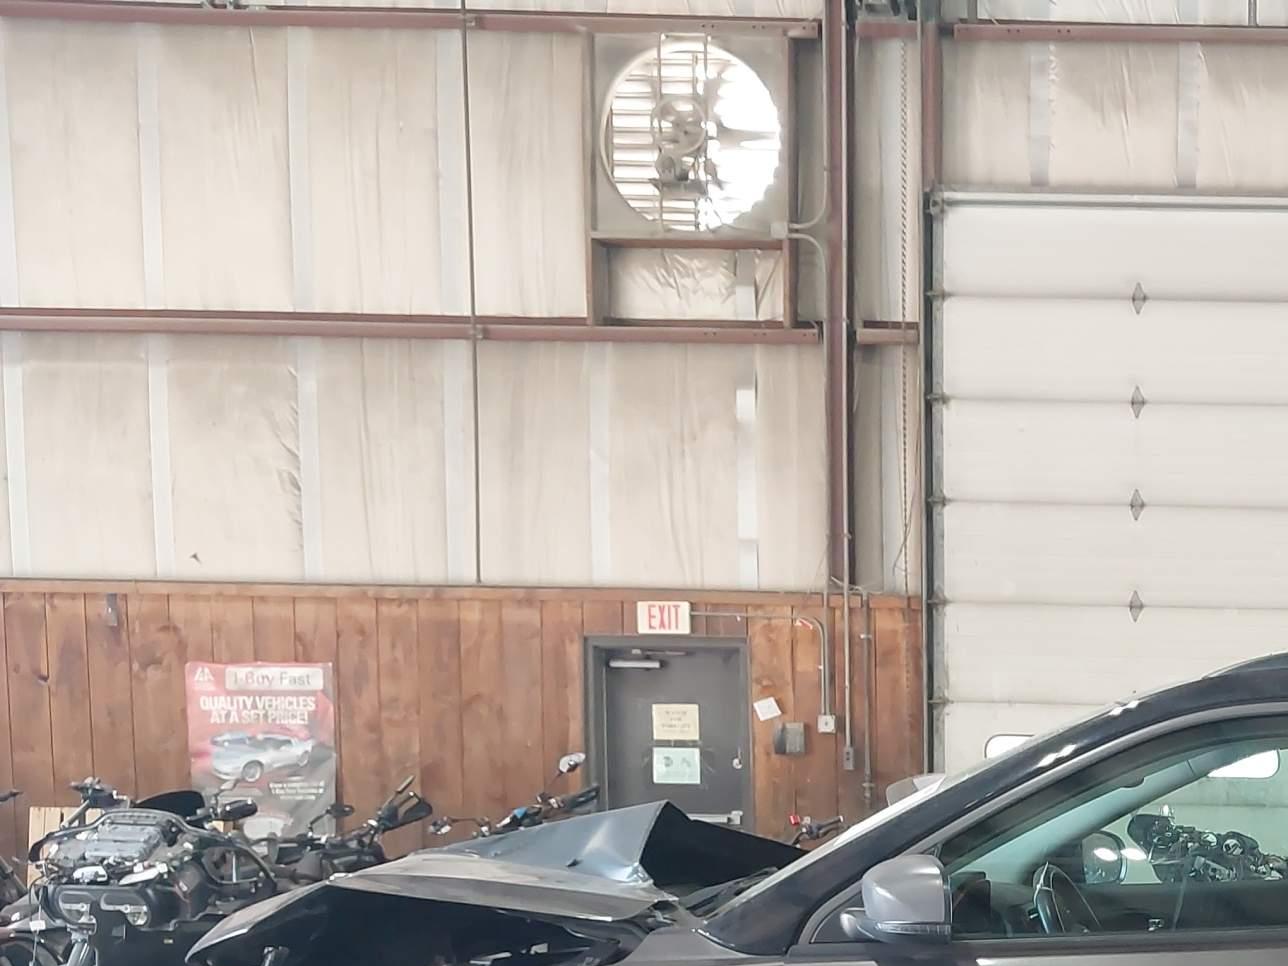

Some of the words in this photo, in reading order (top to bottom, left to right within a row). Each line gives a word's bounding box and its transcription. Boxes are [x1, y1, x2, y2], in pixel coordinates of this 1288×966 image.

[648, 604, 681, 630] EXIT
[280, 671, 312, 686] Fast
[200, 695, 254, 711] QUALITY
[255, 695, 316, 711] VEHICLES
[210, 710, 228, 724] AT
[229, 710, 240, 724] A
[241, 710, 266, 724] SET
[268, 710, 309, 724] PRICE!
